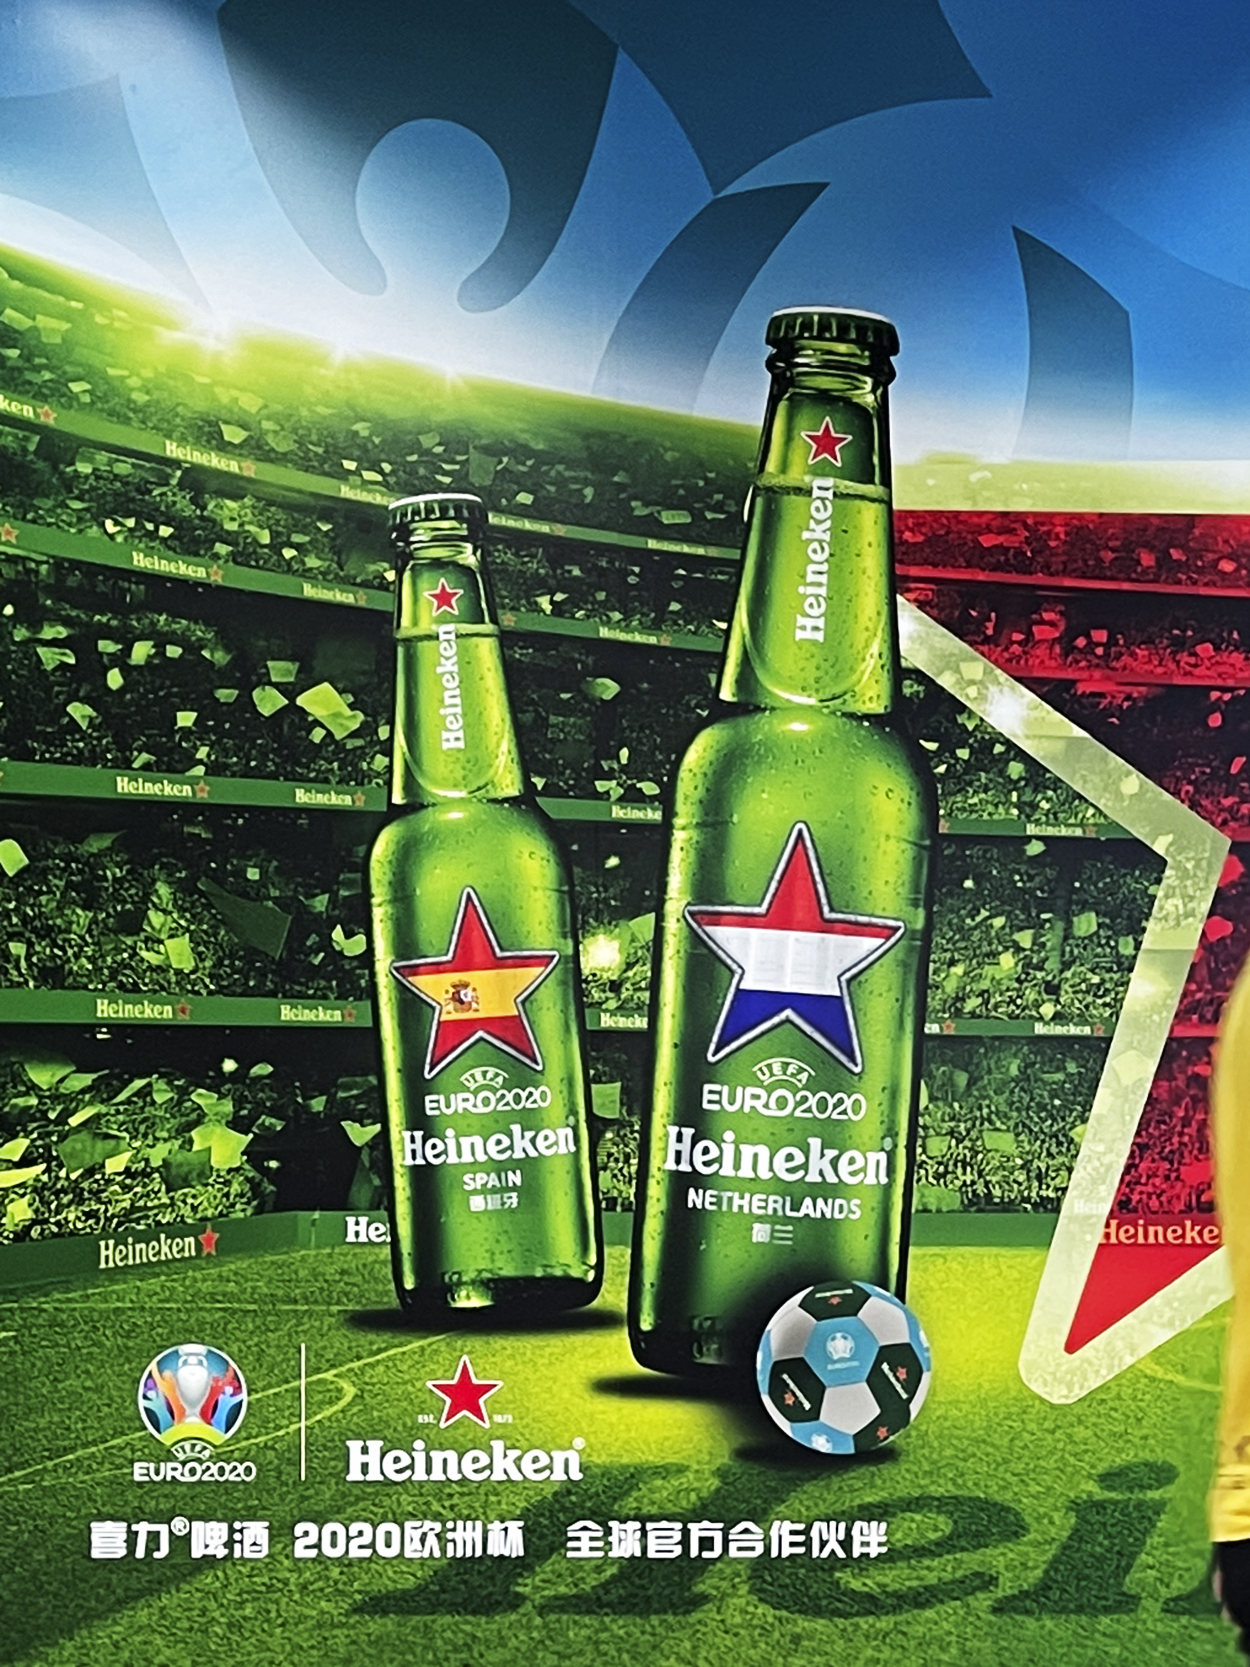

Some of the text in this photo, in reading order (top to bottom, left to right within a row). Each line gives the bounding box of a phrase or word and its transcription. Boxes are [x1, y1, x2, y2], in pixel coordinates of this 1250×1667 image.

[164, 439, 240, 473] Heineken
[131, 551, 208, 579] Heineken
[793, 476, 836, 643] Heineken
[302, 582, 356, 604] Heineken
[436, 623, 466, 751] Heineken
[116, 776, 193, 797] Heineken
[294, 788, 354, 806] Heineken
[611, 804, 662, 820] Heineke
[1025, 823, 1084, 836] Heineken
[95, 998, 173, 1020] Heineken
[279, 1004, 343, 1022] Heineken
[600, 1012, 649, 1029] Heineke
[1033, 1021, 1092, 1036] Heineken
[755, 1060, 812, 1087] UEFA
[424, 1085, 552, 1116] EURO2020
[701, 1083, 868, 1122] EURO2020
[402, 1123, 577, 1167] Heineken
[663, 1125, 890, 1186] Heineken
[462, 1169, 523, 1191] SPAIN
[686, 1187, 862, 1220] NETHERLANDS
[1099, 1218, 1225, 1245] Heineke
[98, 1234, 197, 1270] Heineken
[133, 1461, 257, 1483] EURO2020
[293, 1519, 526, 1560] 2020欧洲杯
[565, 1519, 889, 1560] 全球官方合作伙伴
